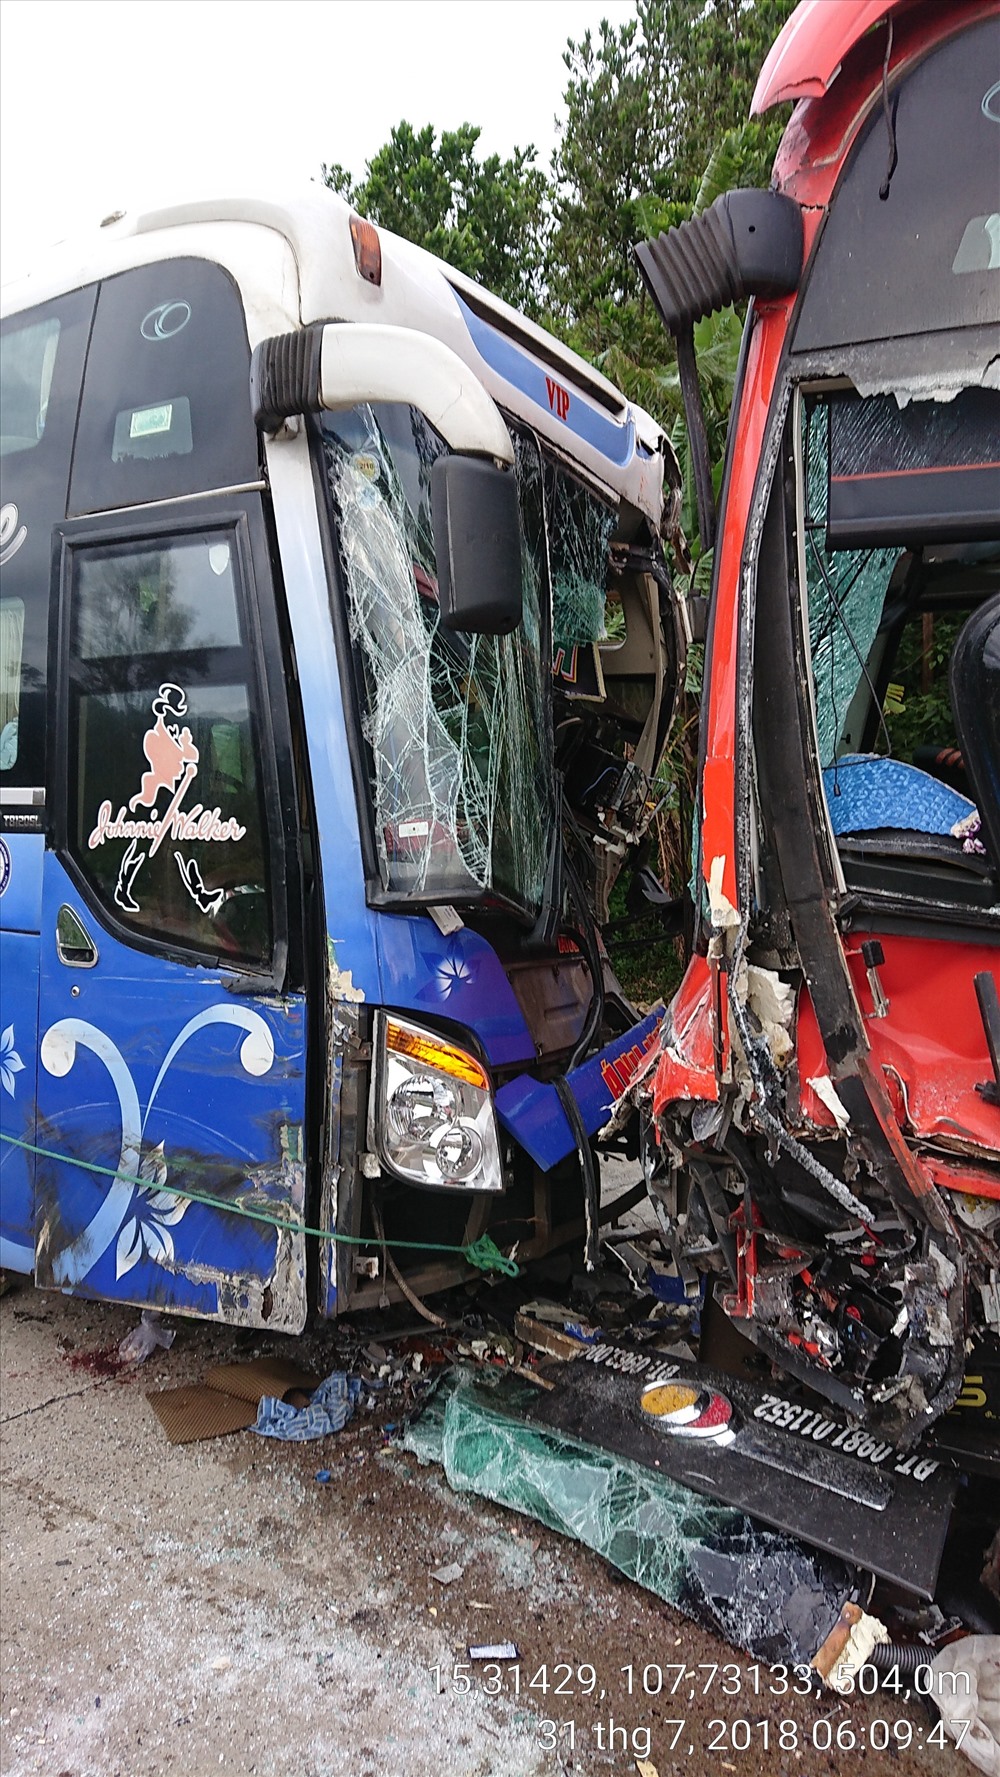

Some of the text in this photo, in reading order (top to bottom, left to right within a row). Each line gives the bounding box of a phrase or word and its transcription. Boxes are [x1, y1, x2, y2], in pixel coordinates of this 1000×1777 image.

[545, 376, 570, 421] VIP
[88, 800, 247, 849] Johnnie Walker
